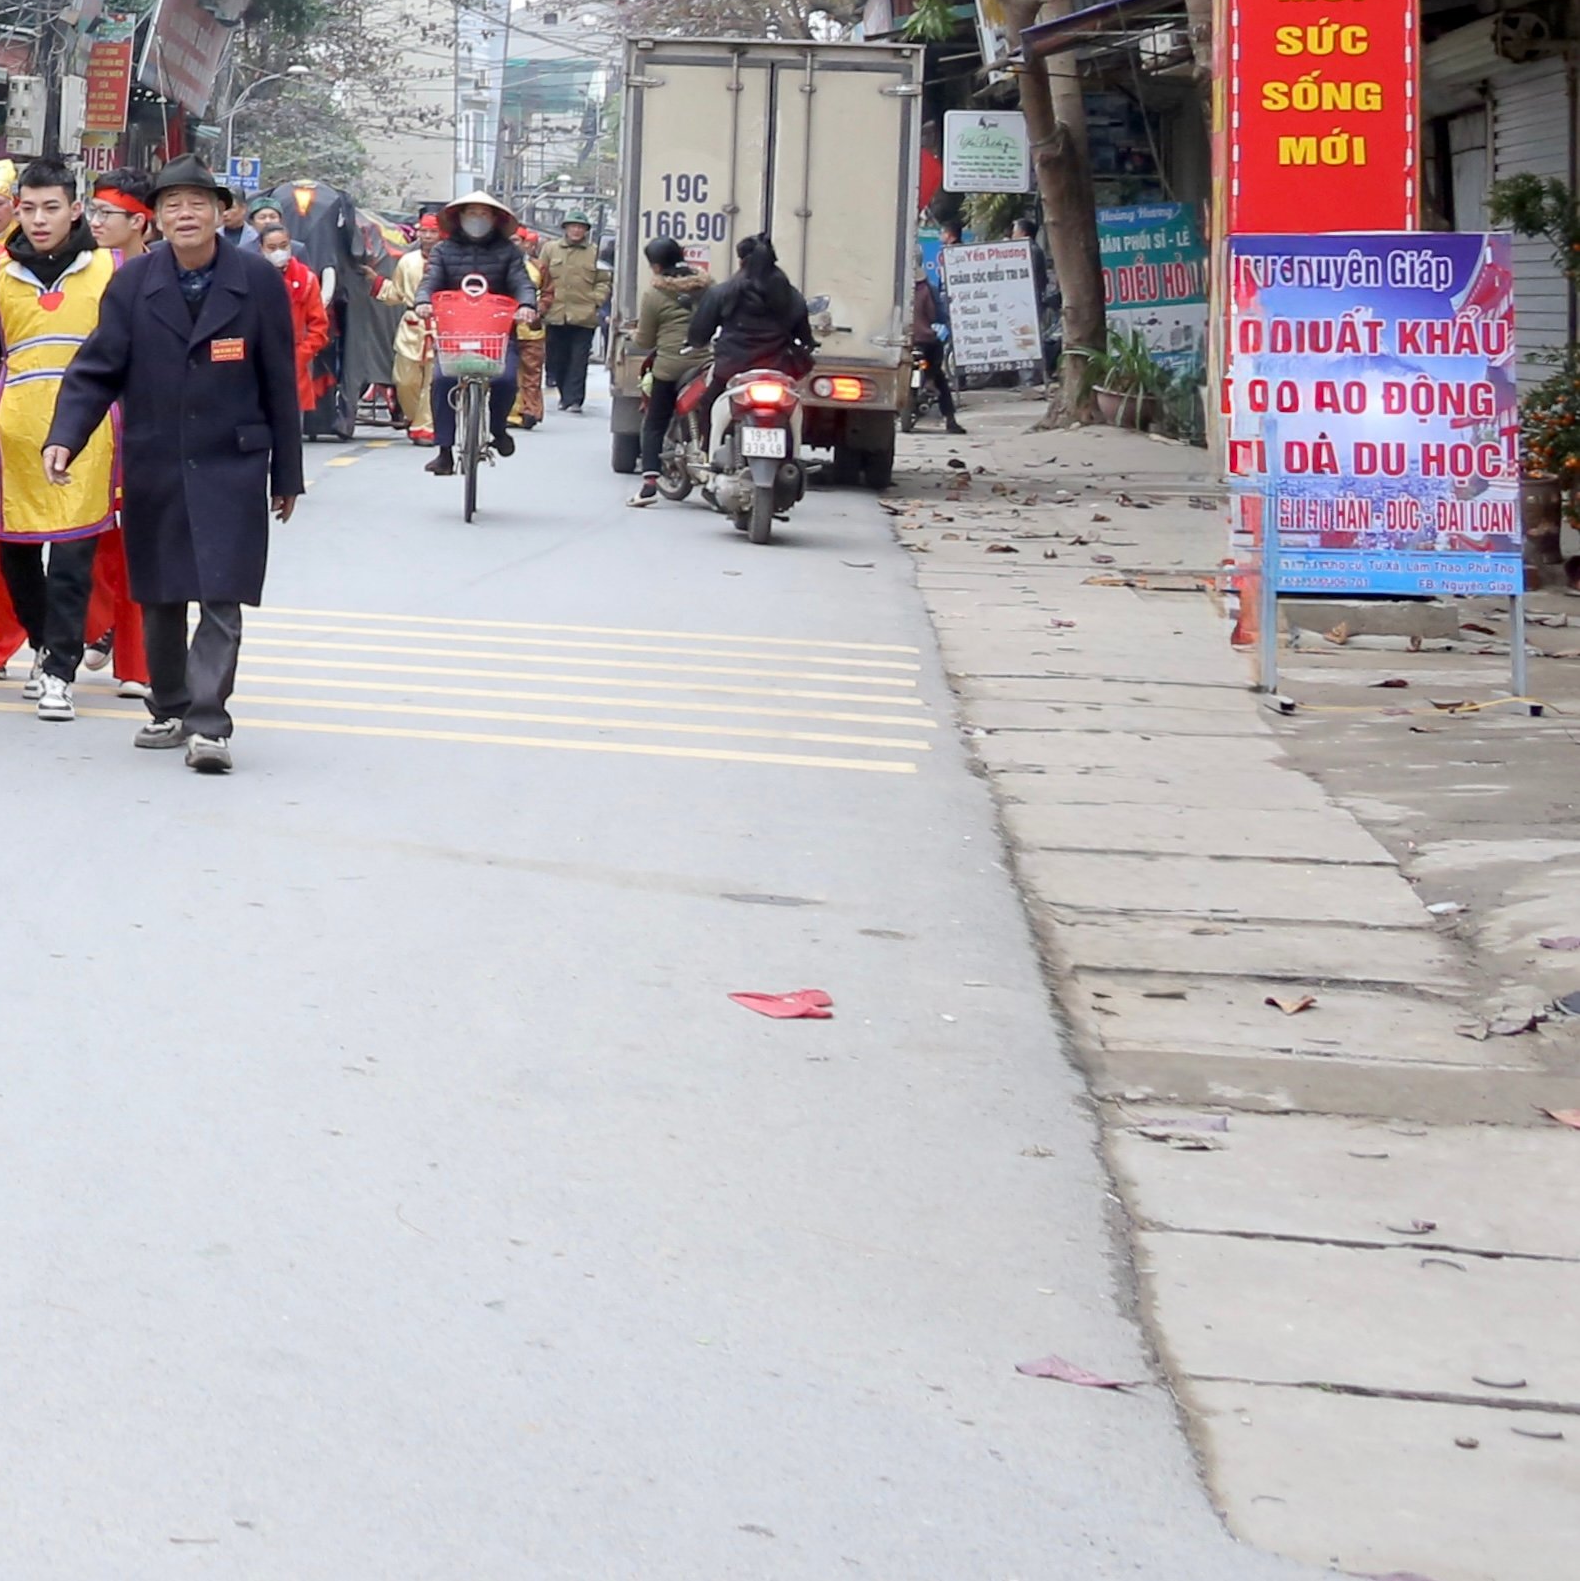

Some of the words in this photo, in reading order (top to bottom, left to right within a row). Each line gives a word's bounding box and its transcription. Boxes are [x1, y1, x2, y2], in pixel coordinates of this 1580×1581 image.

[1275, 16, 1369, 56] SỨC
[1261, 70, 1383, 111] SỐNG
[1278, 126, 1367, 166] MỚI
[661, 173, 709, 203] 19C
[642, 209, 727, 242] 166.90
[1387, 248, 1453, 292] Giáp
[1397, 305, 1508, 357] KHẨU
[1381, 374, 1495, 423] ĐỘNG
[1353, 441, 1406, 477] DU
[1334, 492, 1371, 532] HÀN
[1386, 492, 1422, 532] ĐỨC
[1470, 499, 1515, 533] LOAN
